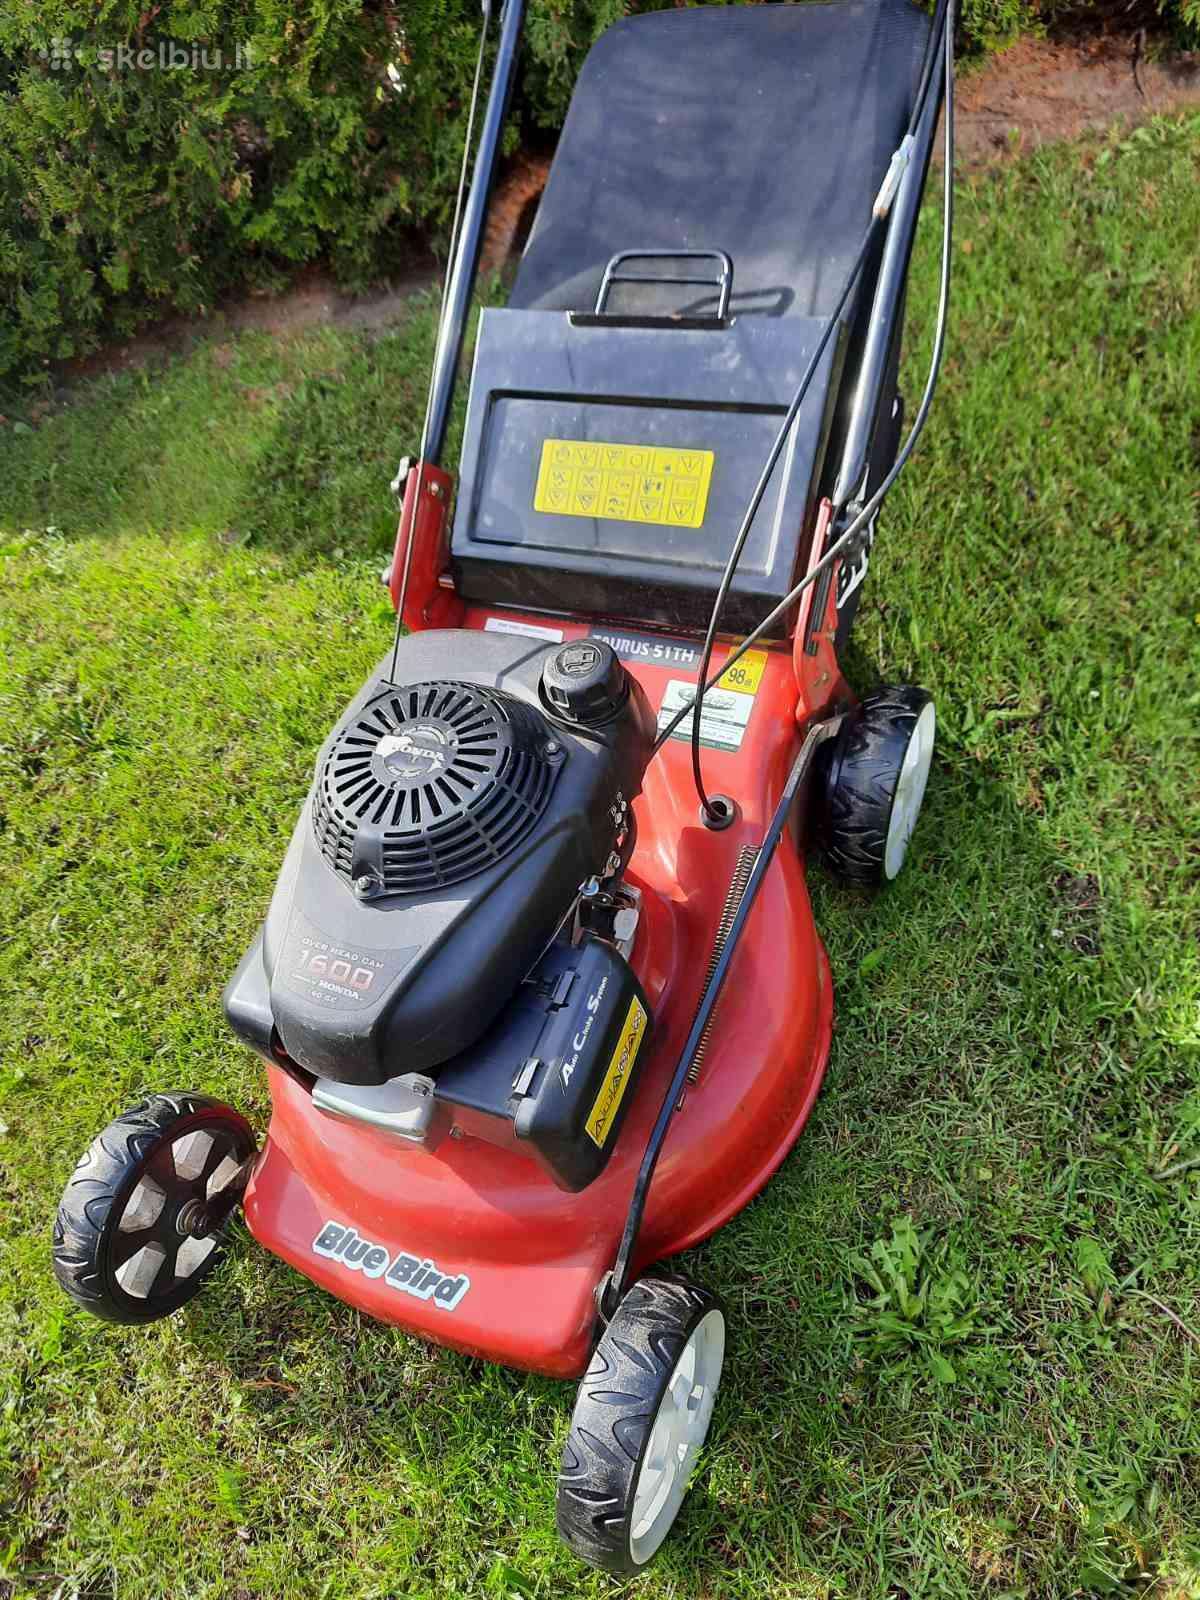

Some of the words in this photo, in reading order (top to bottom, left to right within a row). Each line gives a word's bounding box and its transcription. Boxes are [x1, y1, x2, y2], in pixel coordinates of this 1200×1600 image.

[652, 643, 696, 663] 51TH
[727, 665, 745, 686] 98
[303, 938, 328, 950] OVER
[330, 947, 359, 960] HEAD
[361, 956, 384, 969] CAM
[300, 949, 374, 989] 1600
[318, 979, 359, 1000] HONDA
[314, 1221, 388, 1275] Blue
[386, 1252, 469, 1309] Bird
